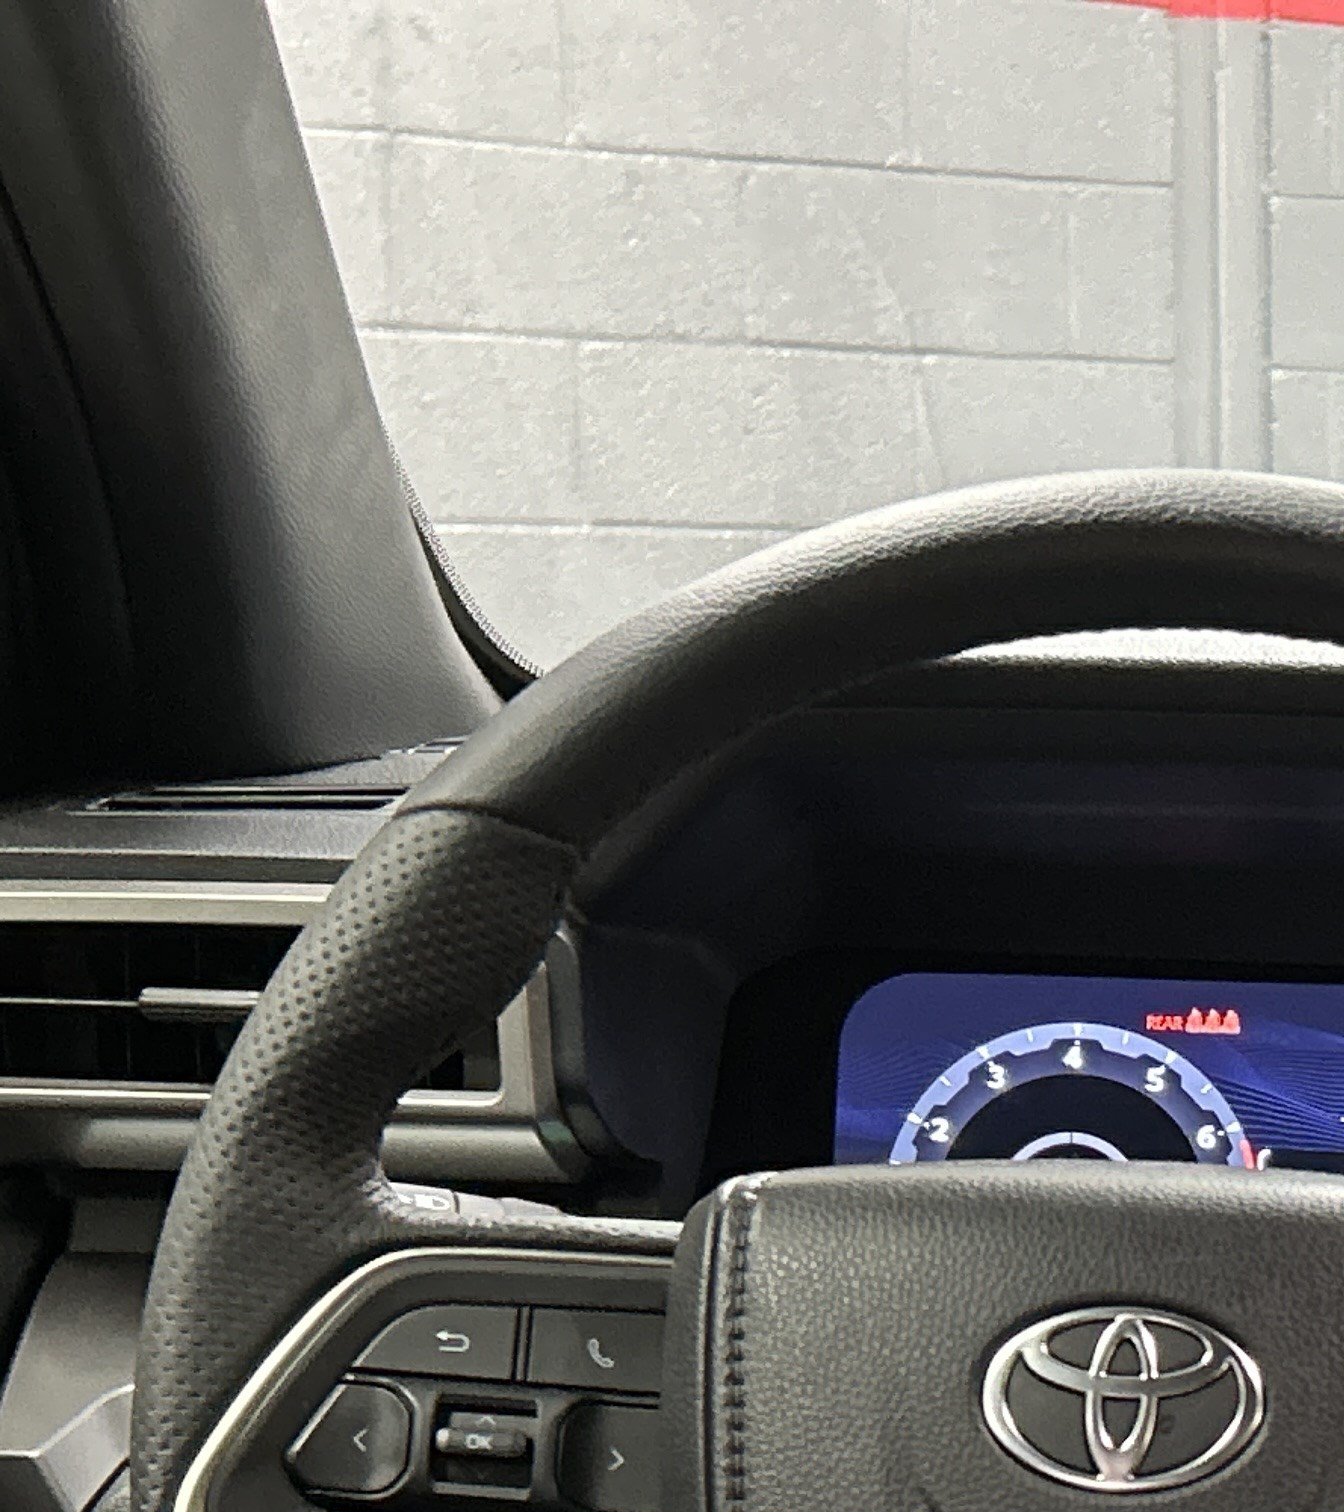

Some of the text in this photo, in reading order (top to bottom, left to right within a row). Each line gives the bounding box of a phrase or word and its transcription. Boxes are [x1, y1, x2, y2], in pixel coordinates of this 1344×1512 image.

[1146, 1014, 1183, 1031] REAR
[1062, 1045, 1083, 1070] 4
[986, 1064, 1007, 1090] 3
[1145, 1066, 1166, 1092] 5
[929, 1117, 950, 1143] 2
[1197, 1126, 1217, 1150] 6
